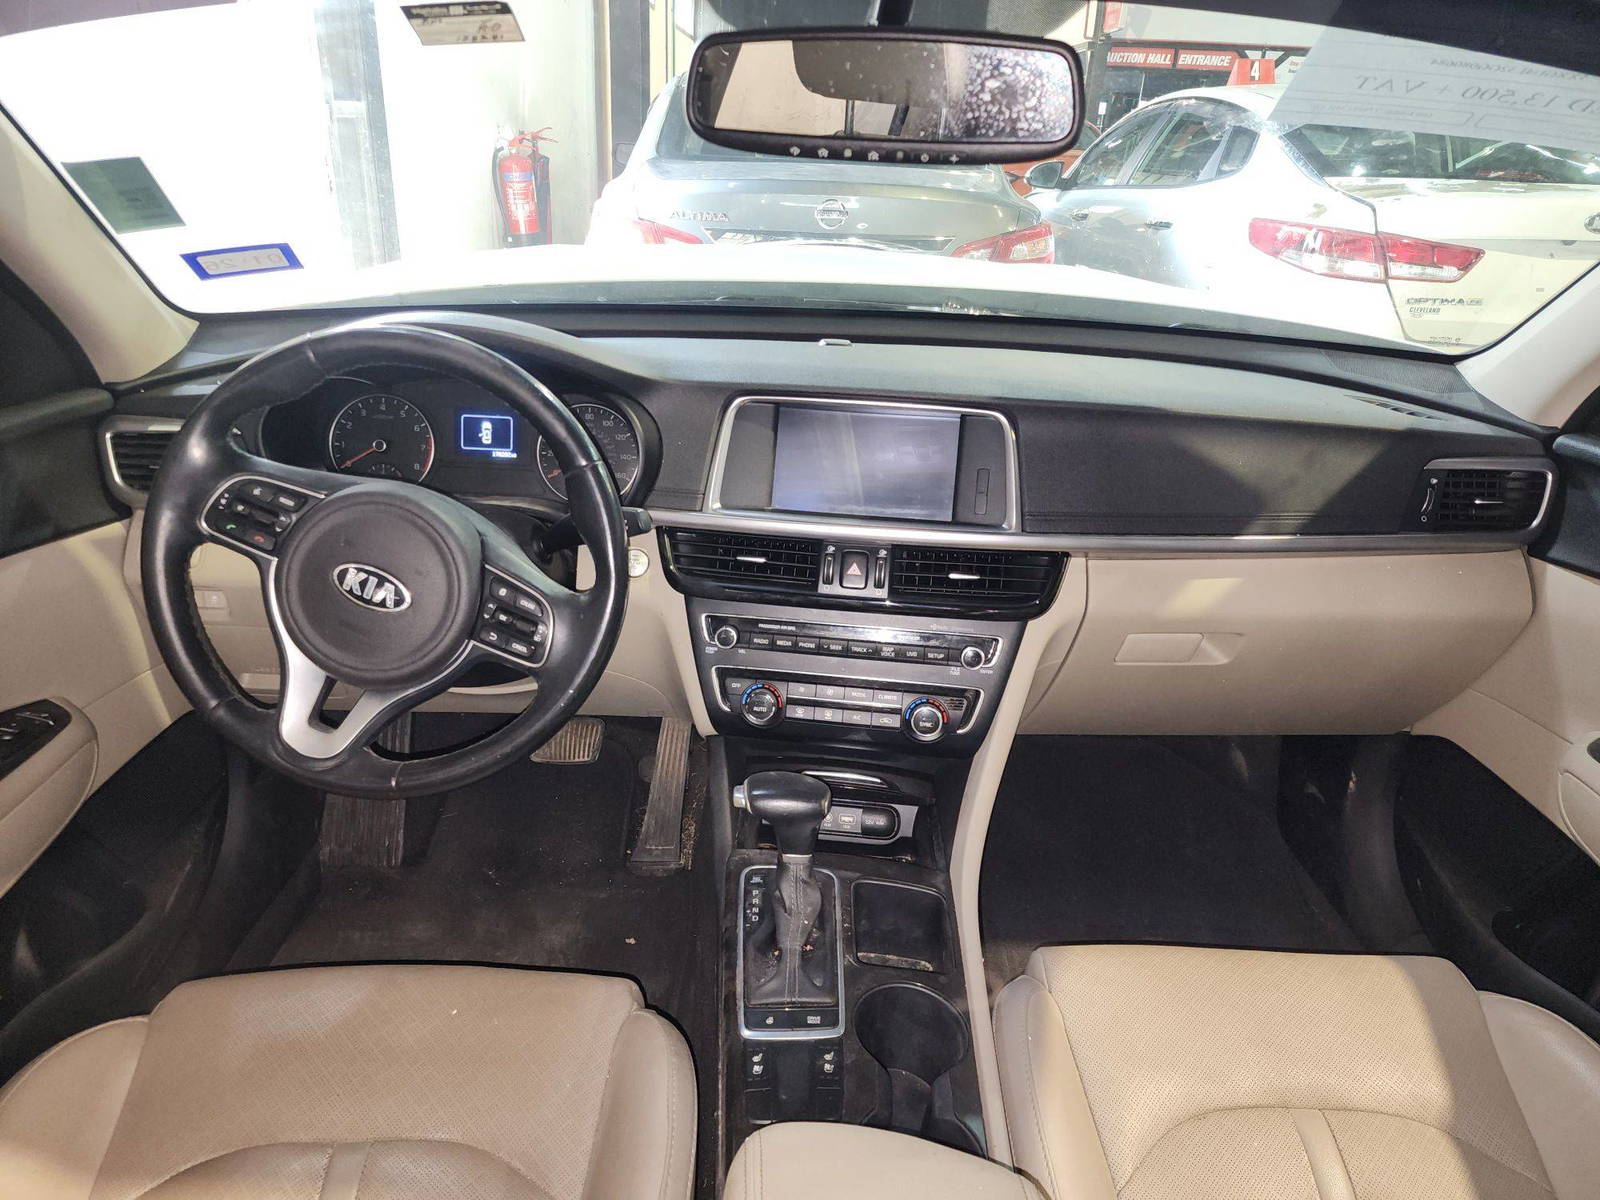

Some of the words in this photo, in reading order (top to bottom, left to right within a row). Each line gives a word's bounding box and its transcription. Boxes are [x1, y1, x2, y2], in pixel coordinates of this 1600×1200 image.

[1146, 52, 1172, 65] HALL
[1178, 53, 1232, 67] ENTRANCE
[1250, 61, 1261, 81] 4
[342, 567, 395, 609] KIA
